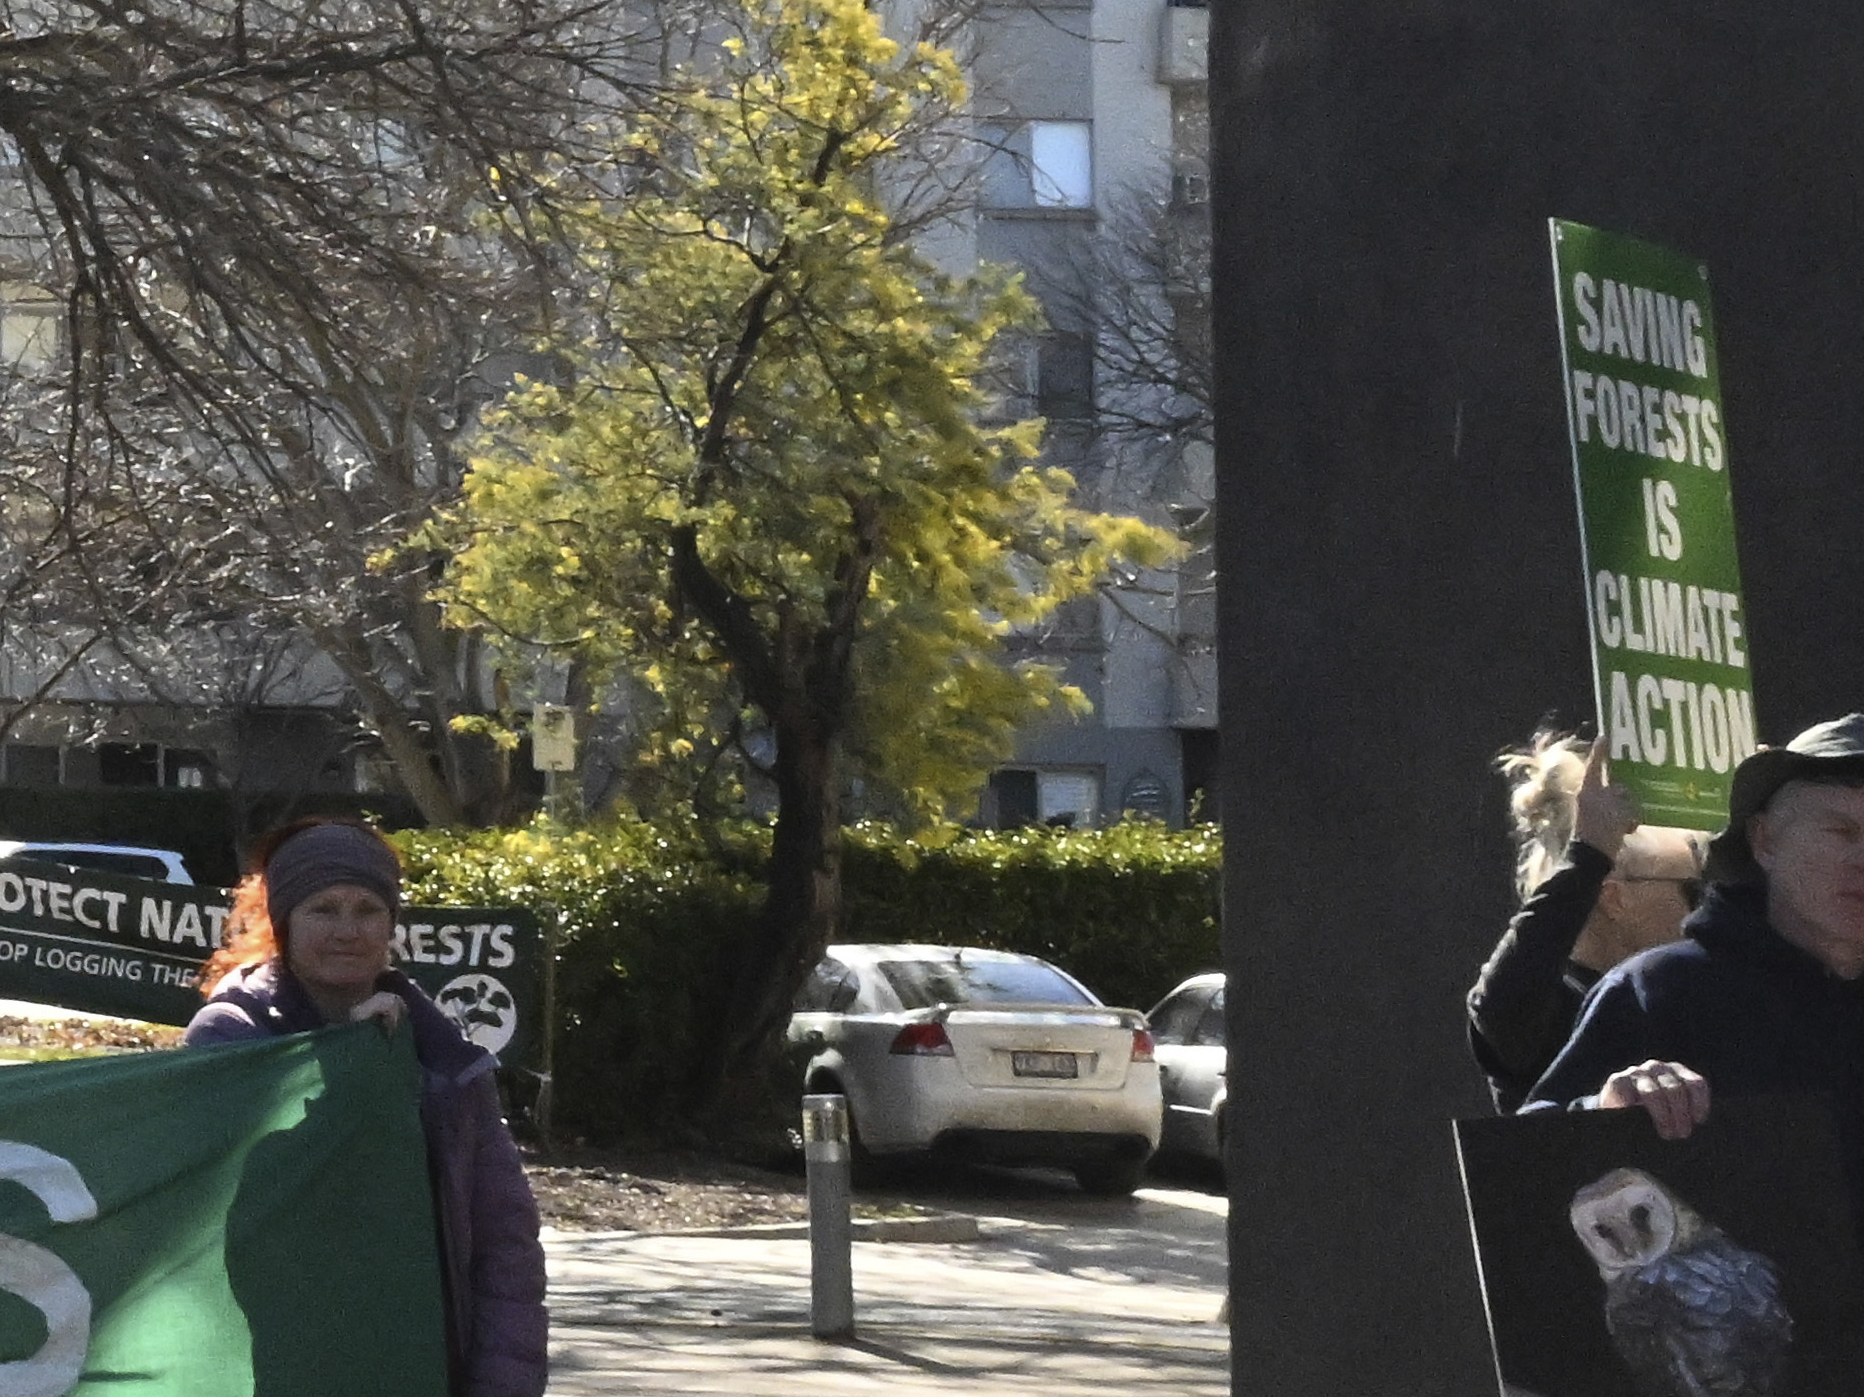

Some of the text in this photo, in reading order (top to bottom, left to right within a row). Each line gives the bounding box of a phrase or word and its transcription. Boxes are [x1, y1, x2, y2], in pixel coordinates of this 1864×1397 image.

[1573, 270, 1708, 379] SAVING
[1574, 368, 1723, 472] FORESTS
[1642, 477, 1683, 561] IS
[1595, 569, 1746, 668] CLIMATE
[1610, 670, 1757, 774] ACTION
[35, 946, 145, 983] LOGGING
[139, 896, 231, 949] NAT
[388, 923, 516, 969] RESTS
